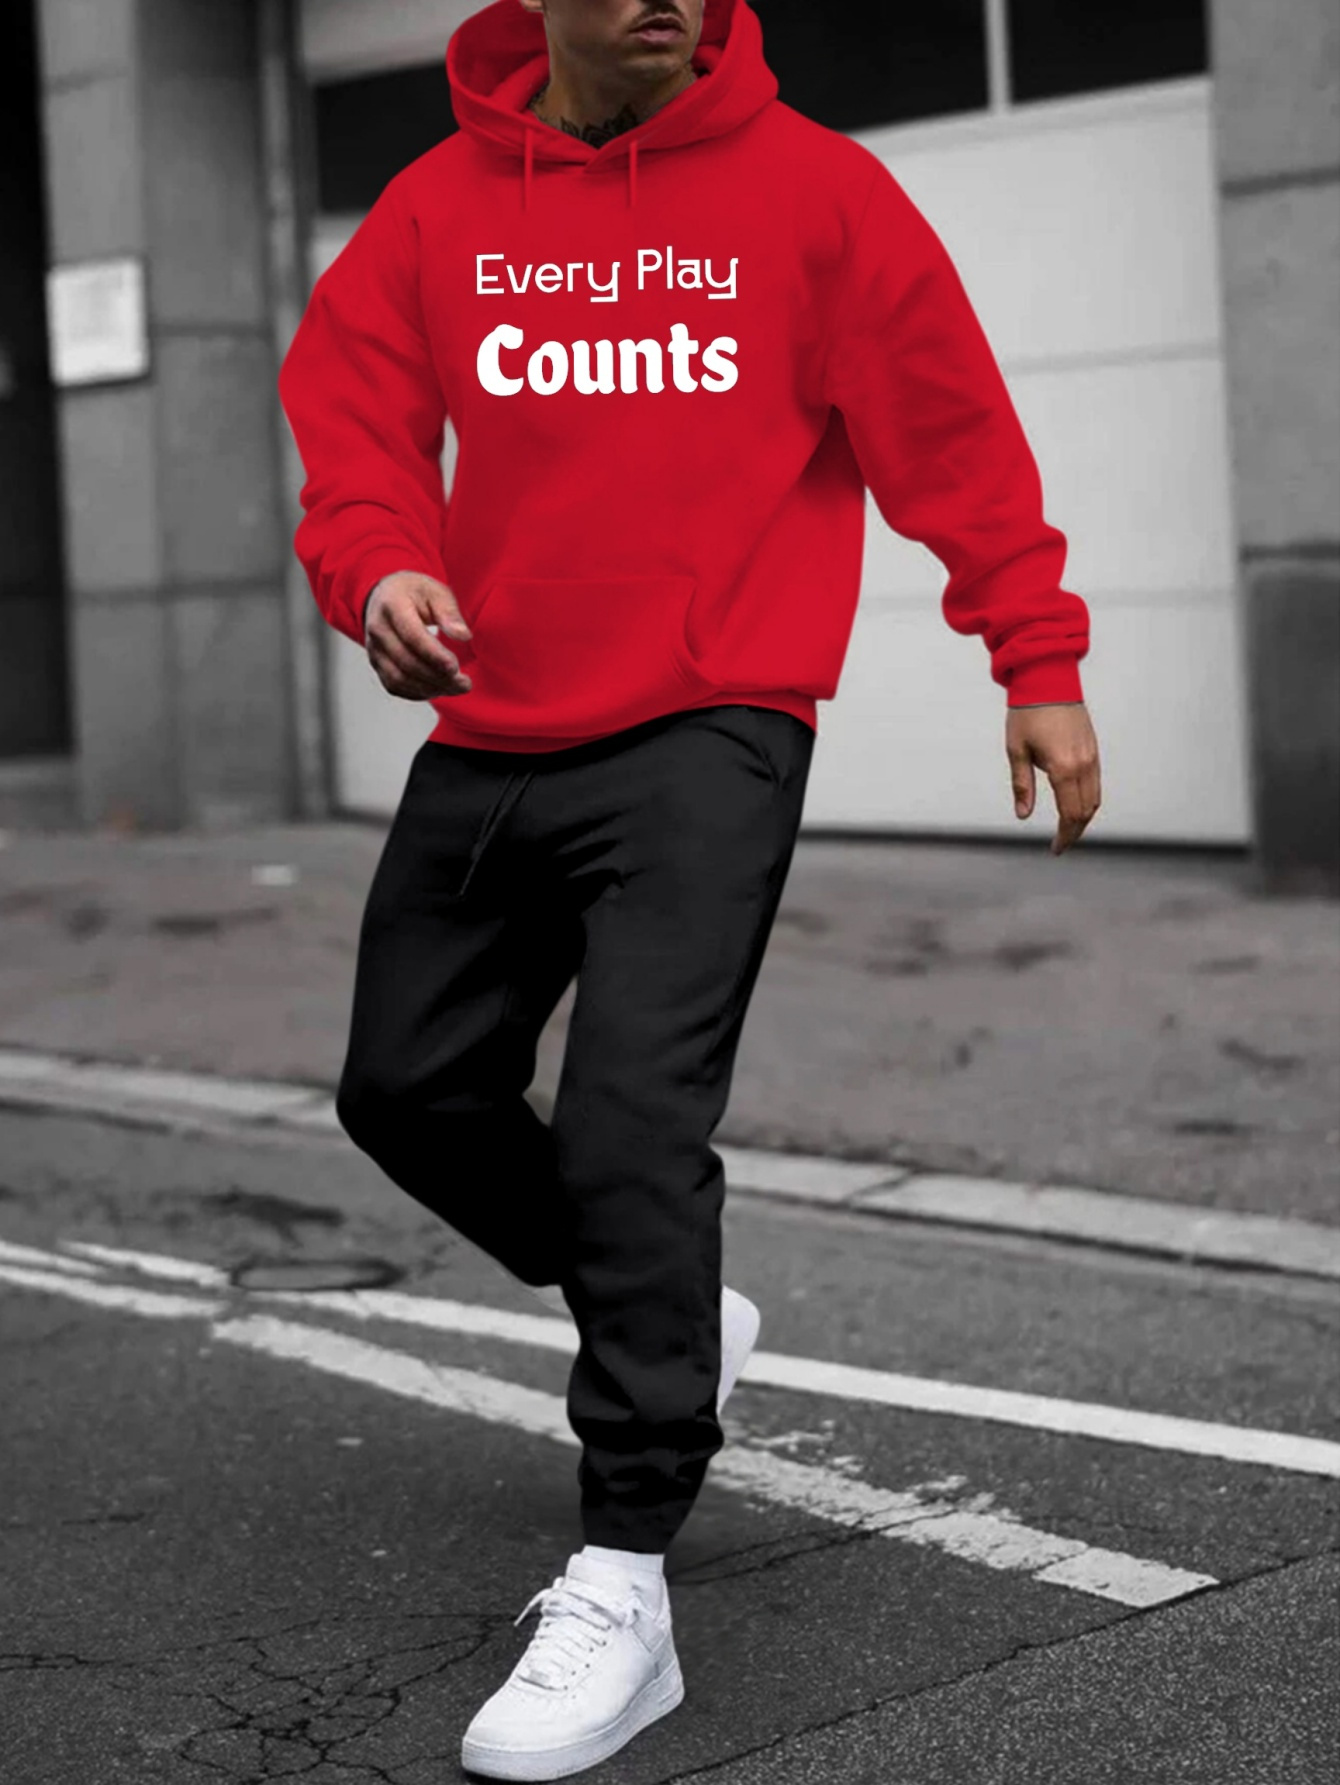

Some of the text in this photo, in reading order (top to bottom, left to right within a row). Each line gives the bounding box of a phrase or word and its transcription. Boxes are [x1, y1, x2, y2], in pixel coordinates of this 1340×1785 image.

[476, 245, 739, 303] Every Play
[476, 322, 739, 397] Counts
